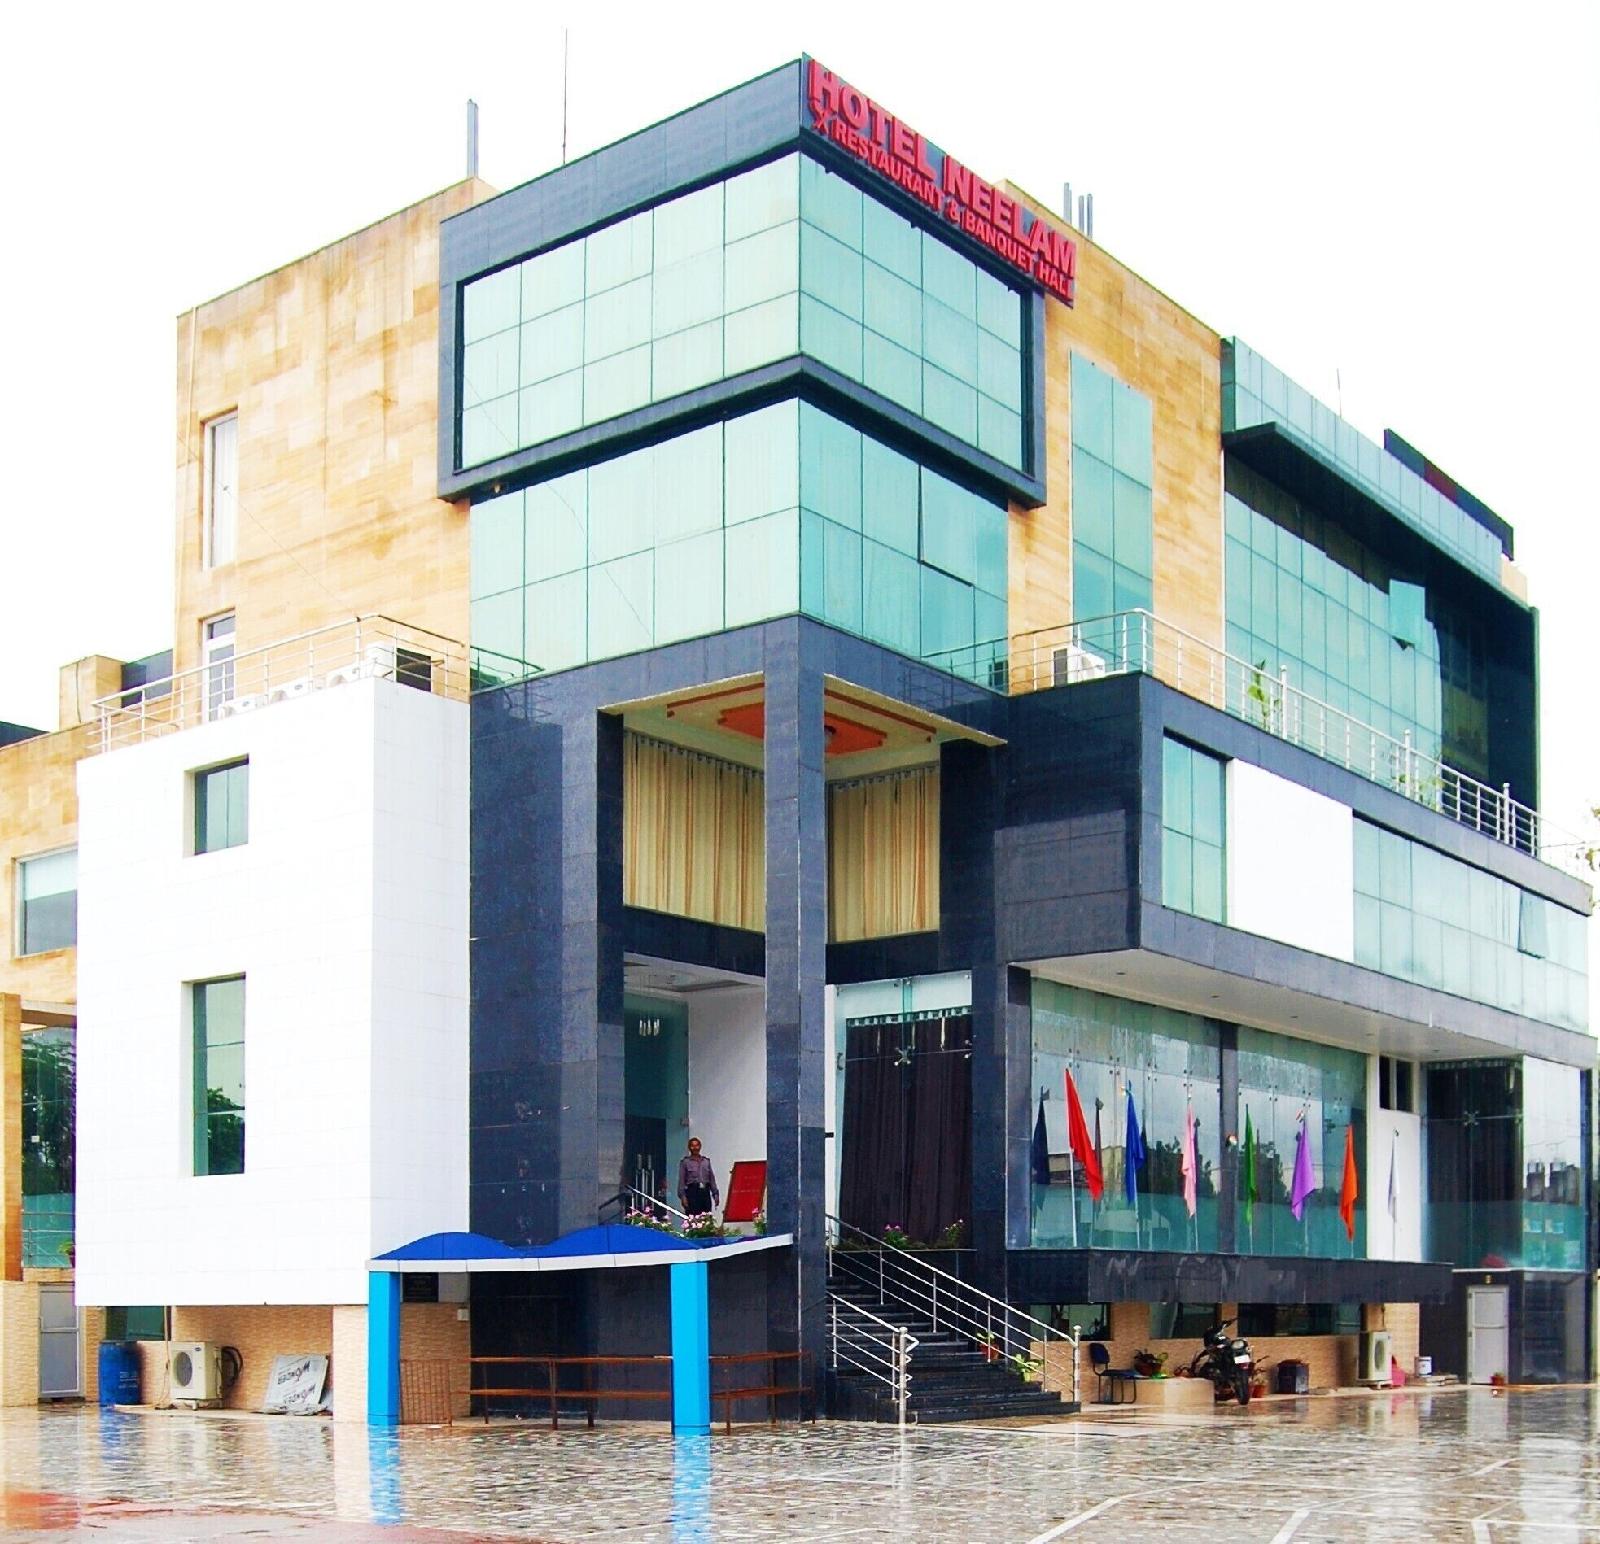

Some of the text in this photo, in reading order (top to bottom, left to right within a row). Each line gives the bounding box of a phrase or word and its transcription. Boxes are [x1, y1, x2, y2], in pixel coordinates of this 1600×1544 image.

[808, 58, 1075, 280] HOTEL NEELAM
[831, 117, 1074, 302] RESTAURANT & BANQUET HALL
